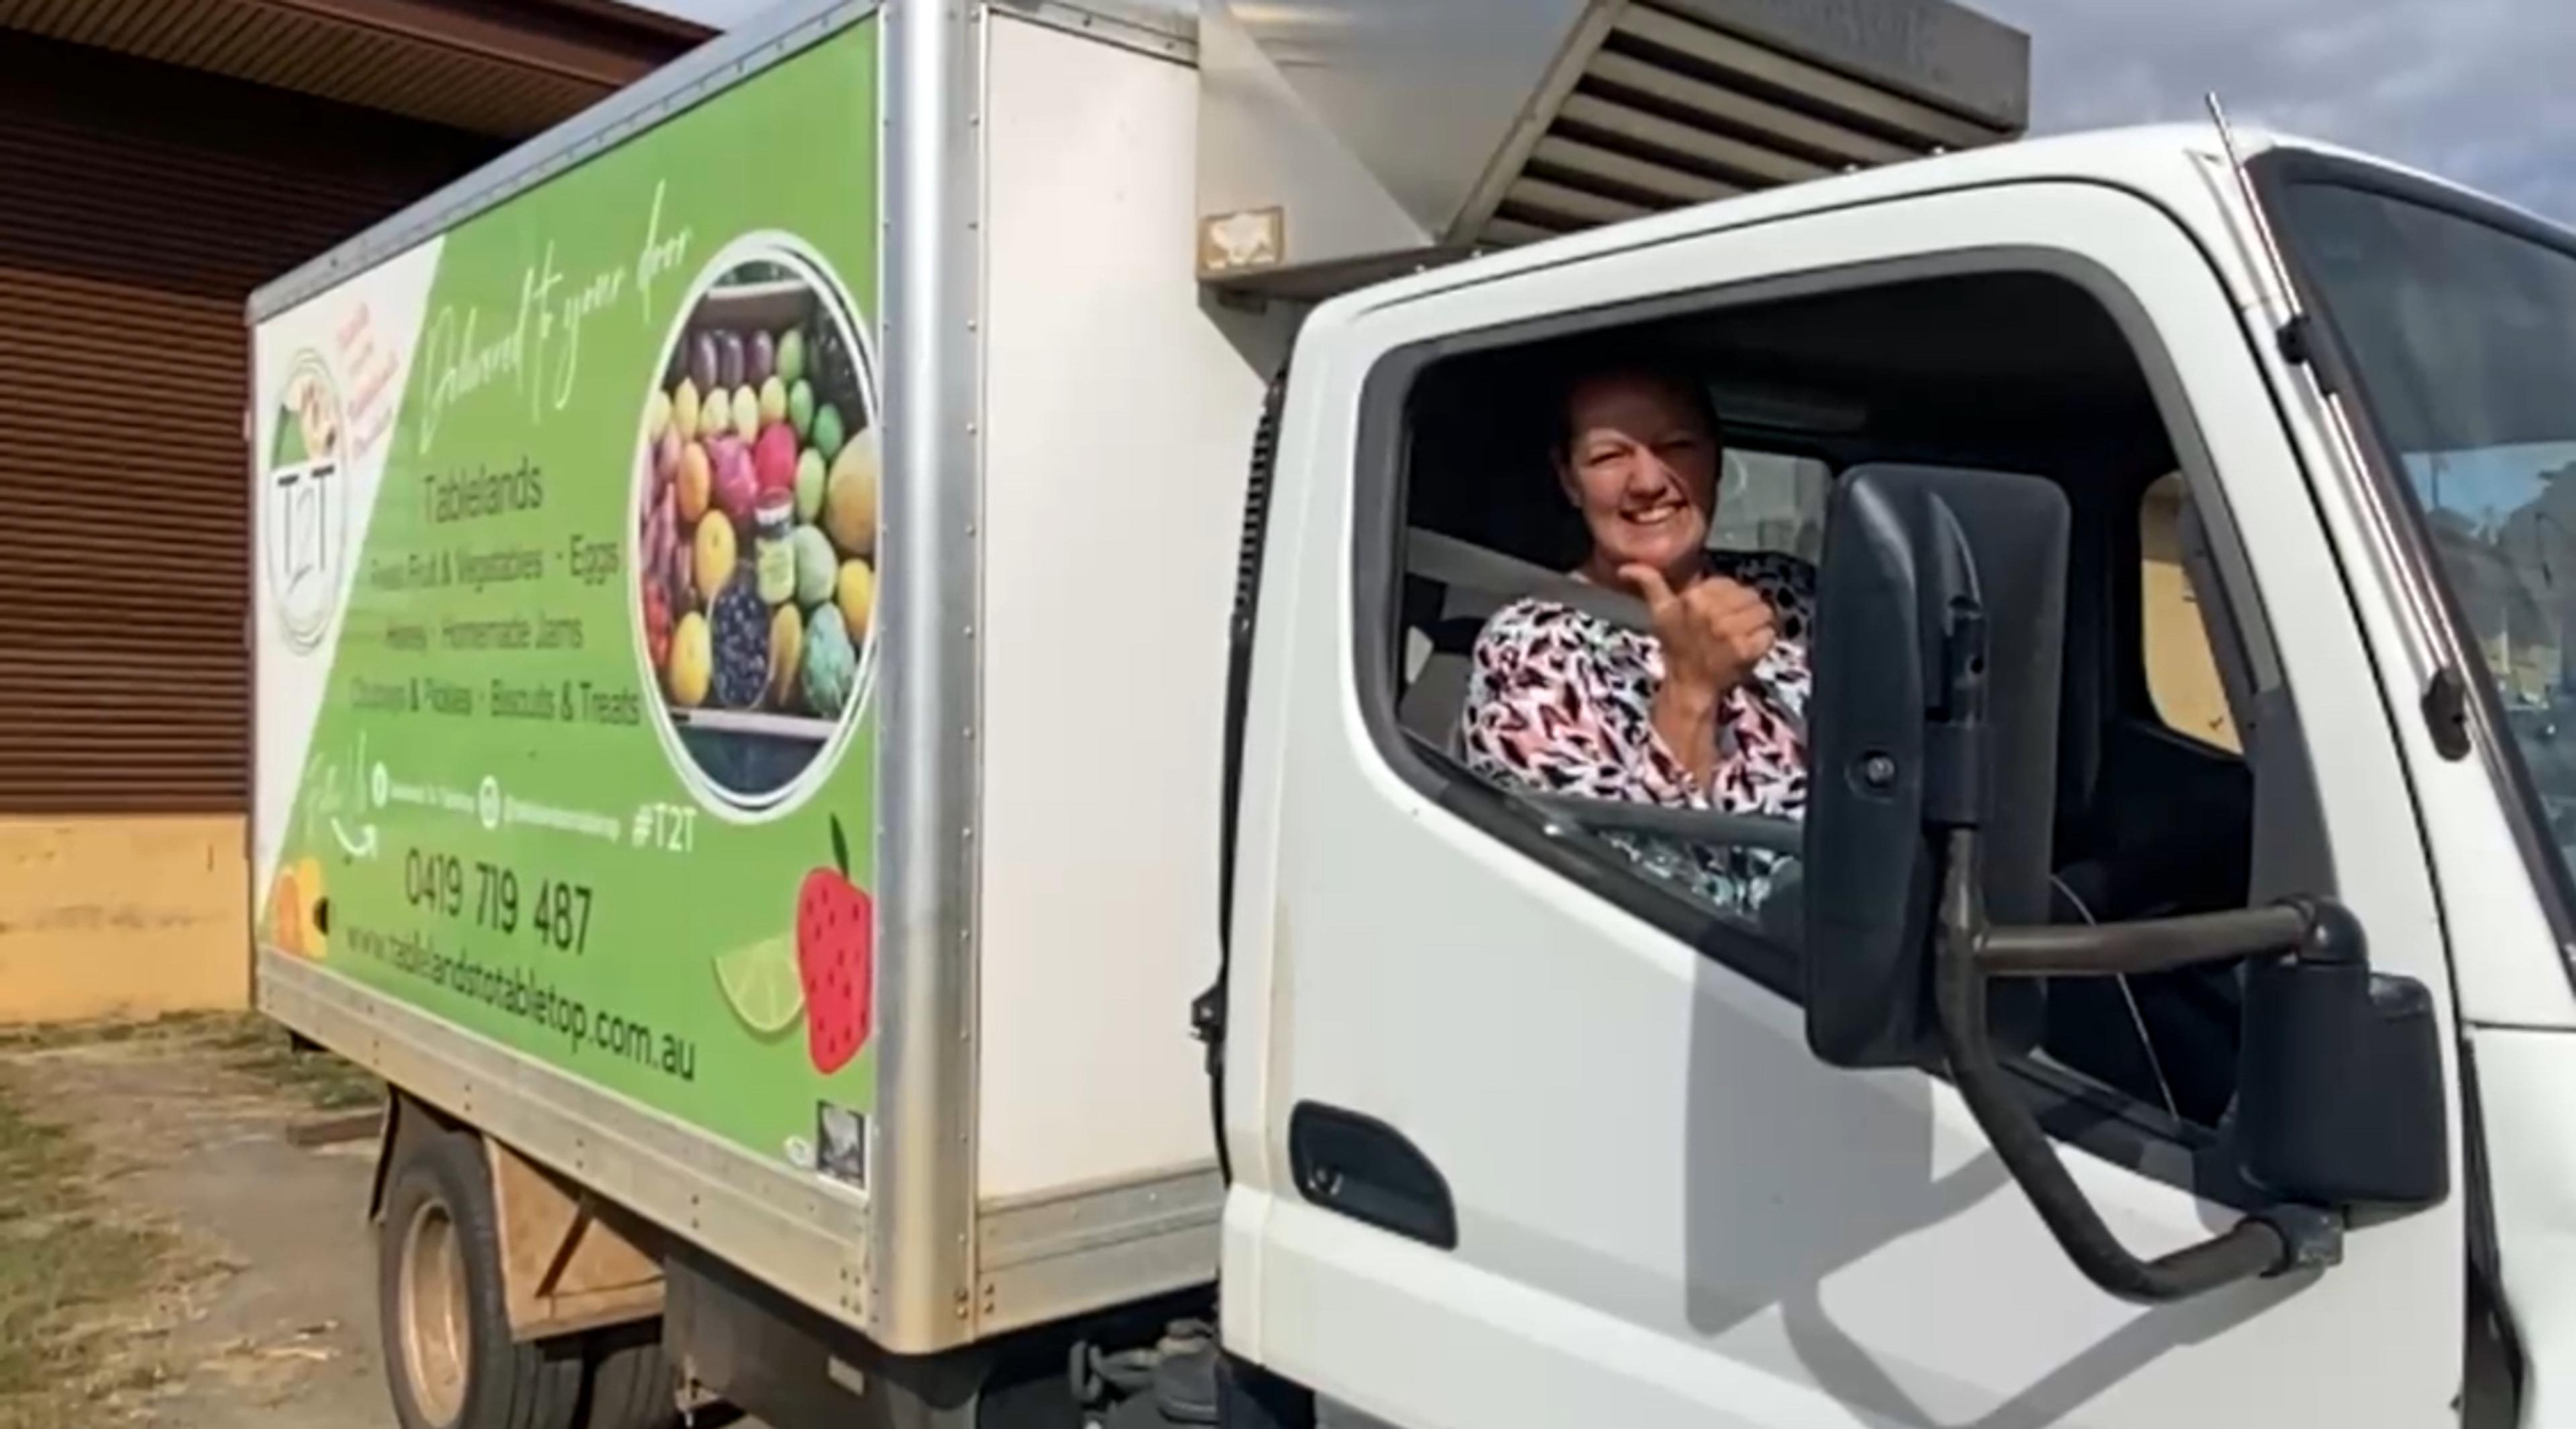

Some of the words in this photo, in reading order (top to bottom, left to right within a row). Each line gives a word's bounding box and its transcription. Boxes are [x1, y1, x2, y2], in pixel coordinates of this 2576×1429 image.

[425, 453, 544, 524] Tablelands
[276, 464, 335, 596] T2T
[570, 534, 620, 586] Eggs
[579, 680, 641, 727] Treats
[632, 801, 698, 853] #T2T
[405, 847, 464, 918] 0419
[475, 861, 519, 935] 719
[532, 878, 593, 957] 487
[345, 926, 696, 1082] www.tablelandstotabletop.com.au
